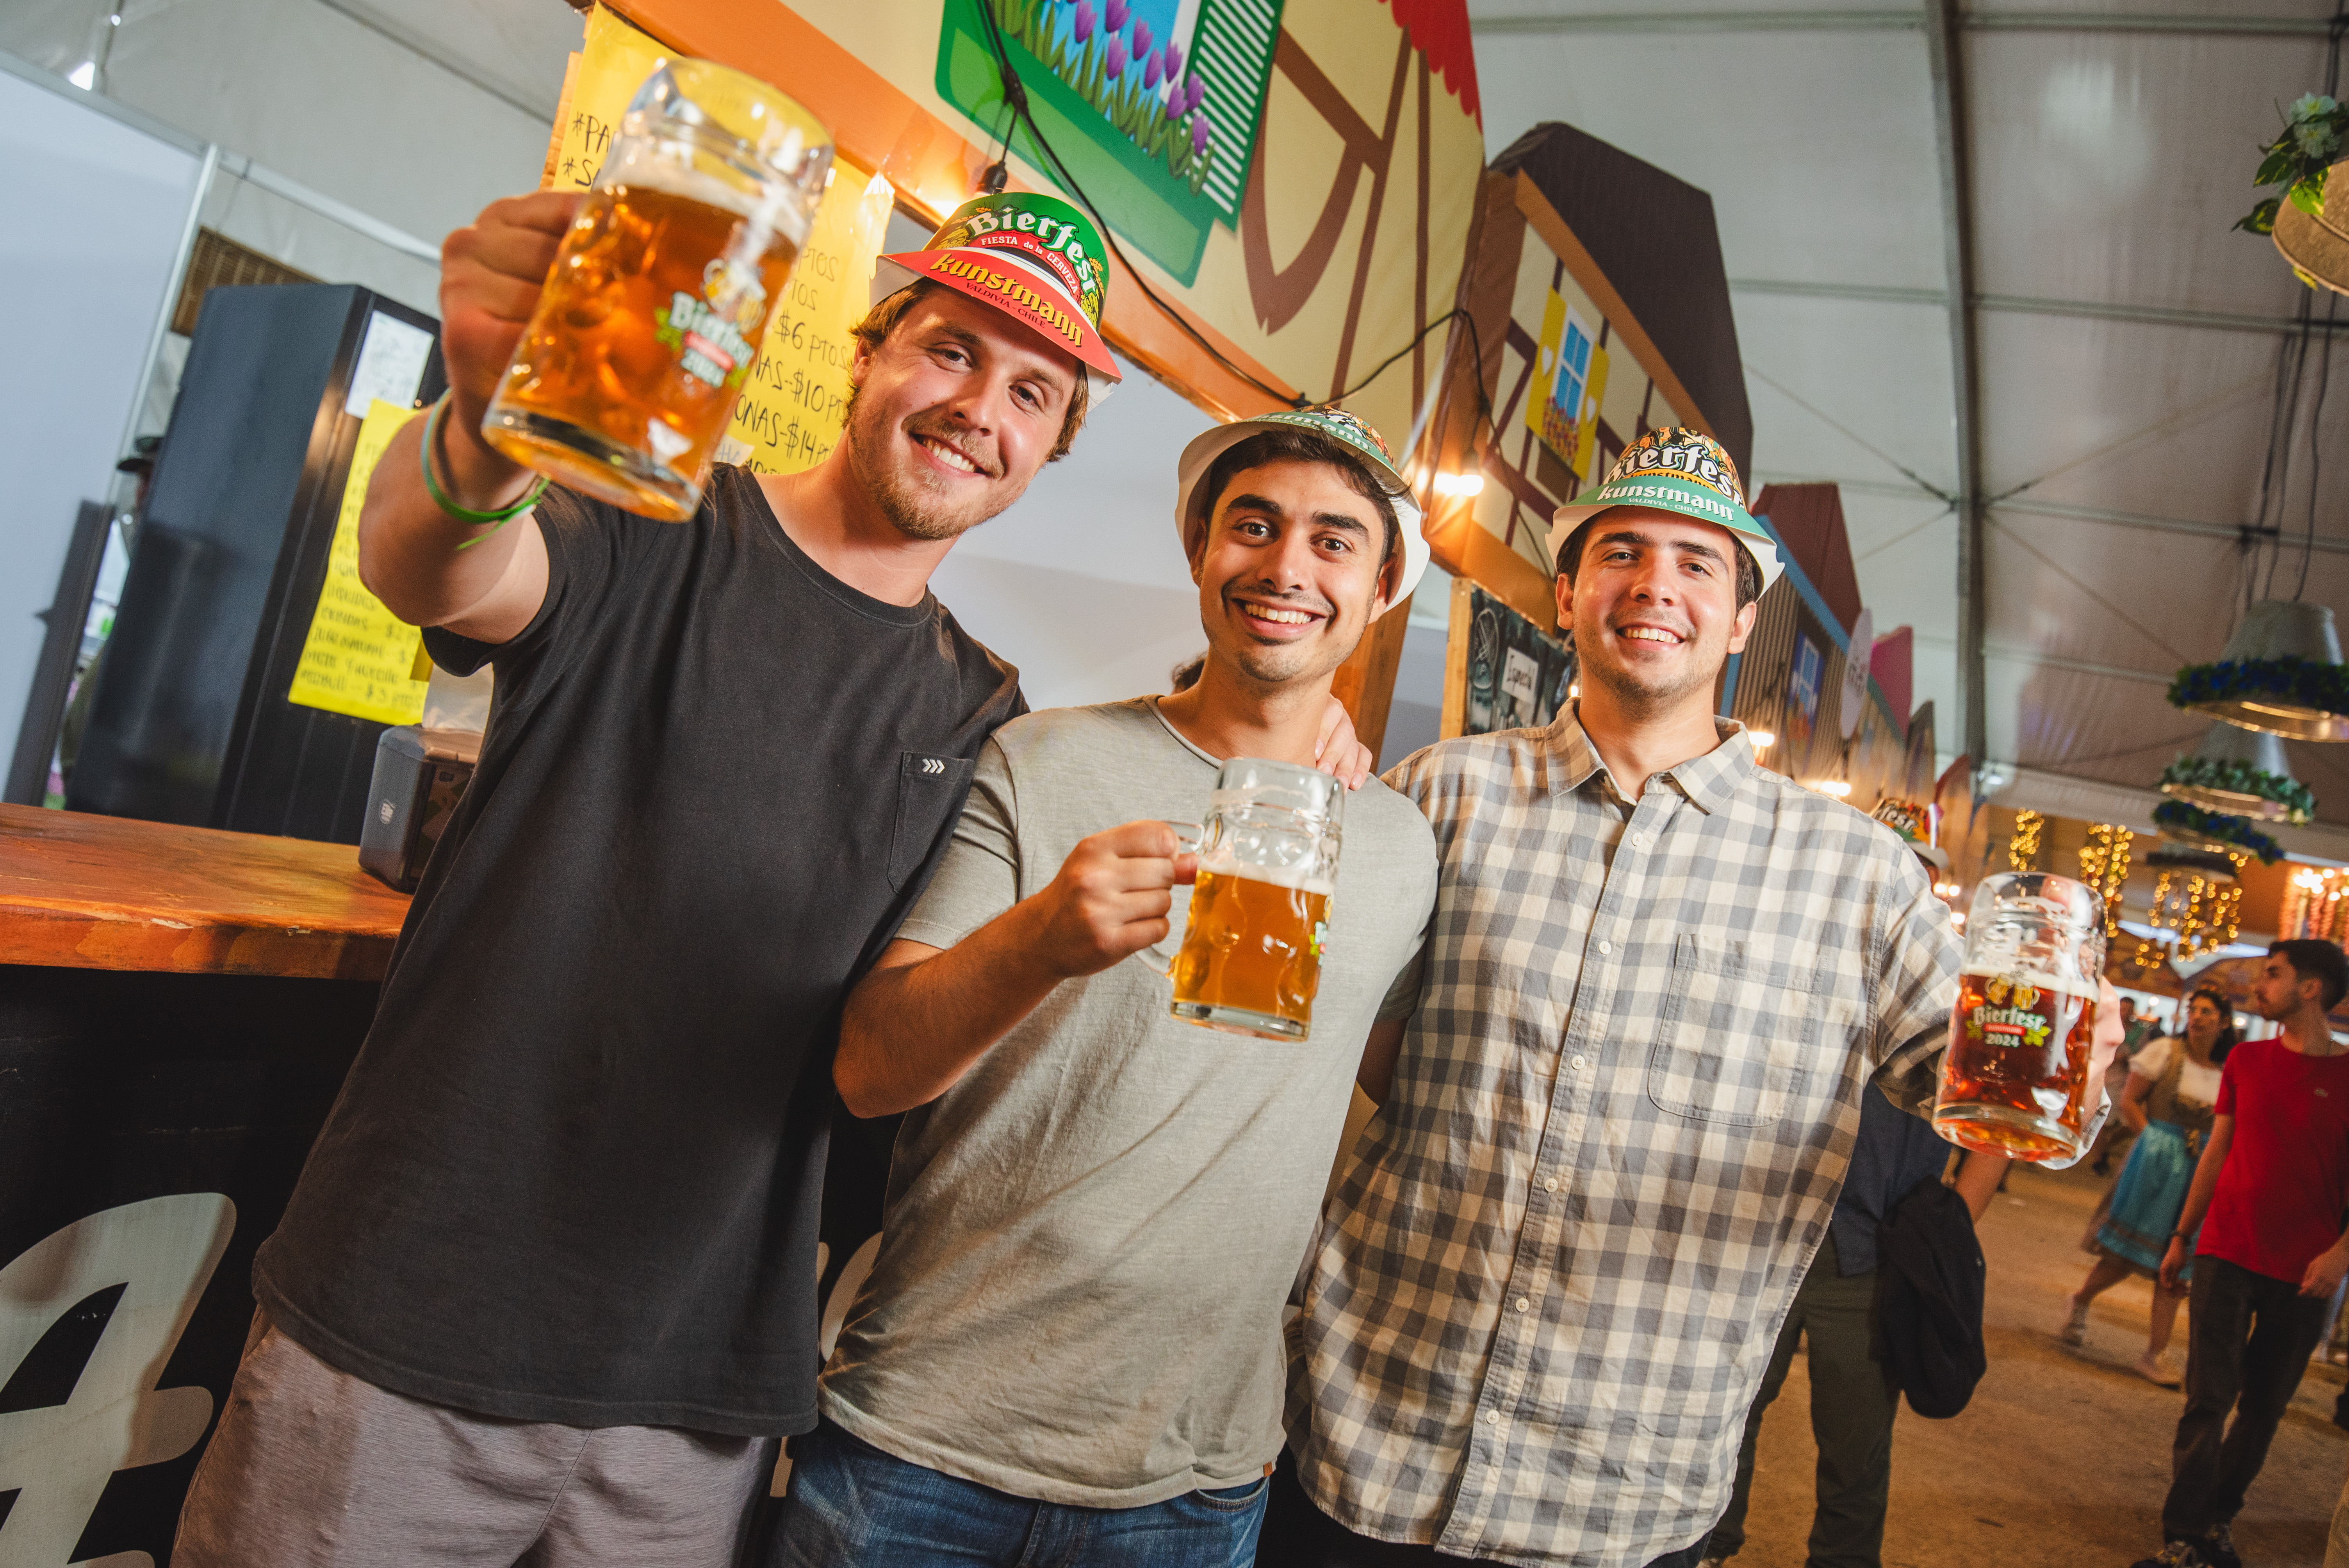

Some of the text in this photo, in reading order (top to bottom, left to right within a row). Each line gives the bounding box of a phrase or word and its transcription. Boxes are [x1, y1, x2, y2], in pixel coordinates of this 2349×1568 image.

[966, 207, 1096, 294] Bierfest
[981, 236, 1078, 295] FIESTA de la CERVEZA
[791, 278, 818, 311] TOS
[930, 253, 1082, 347] kunstmann
[966, 282, 1011, 308] VALDIVIA
[1018, 308, 1046, 328] CHILE
[1597, 485, 1734, 521] kunstmann
[1628, 498, 1668, 507] VALDIVIA
[1674, 504, 1700, 515] CHILE
[1973, 1005, 2047, 1032] Bierfest
